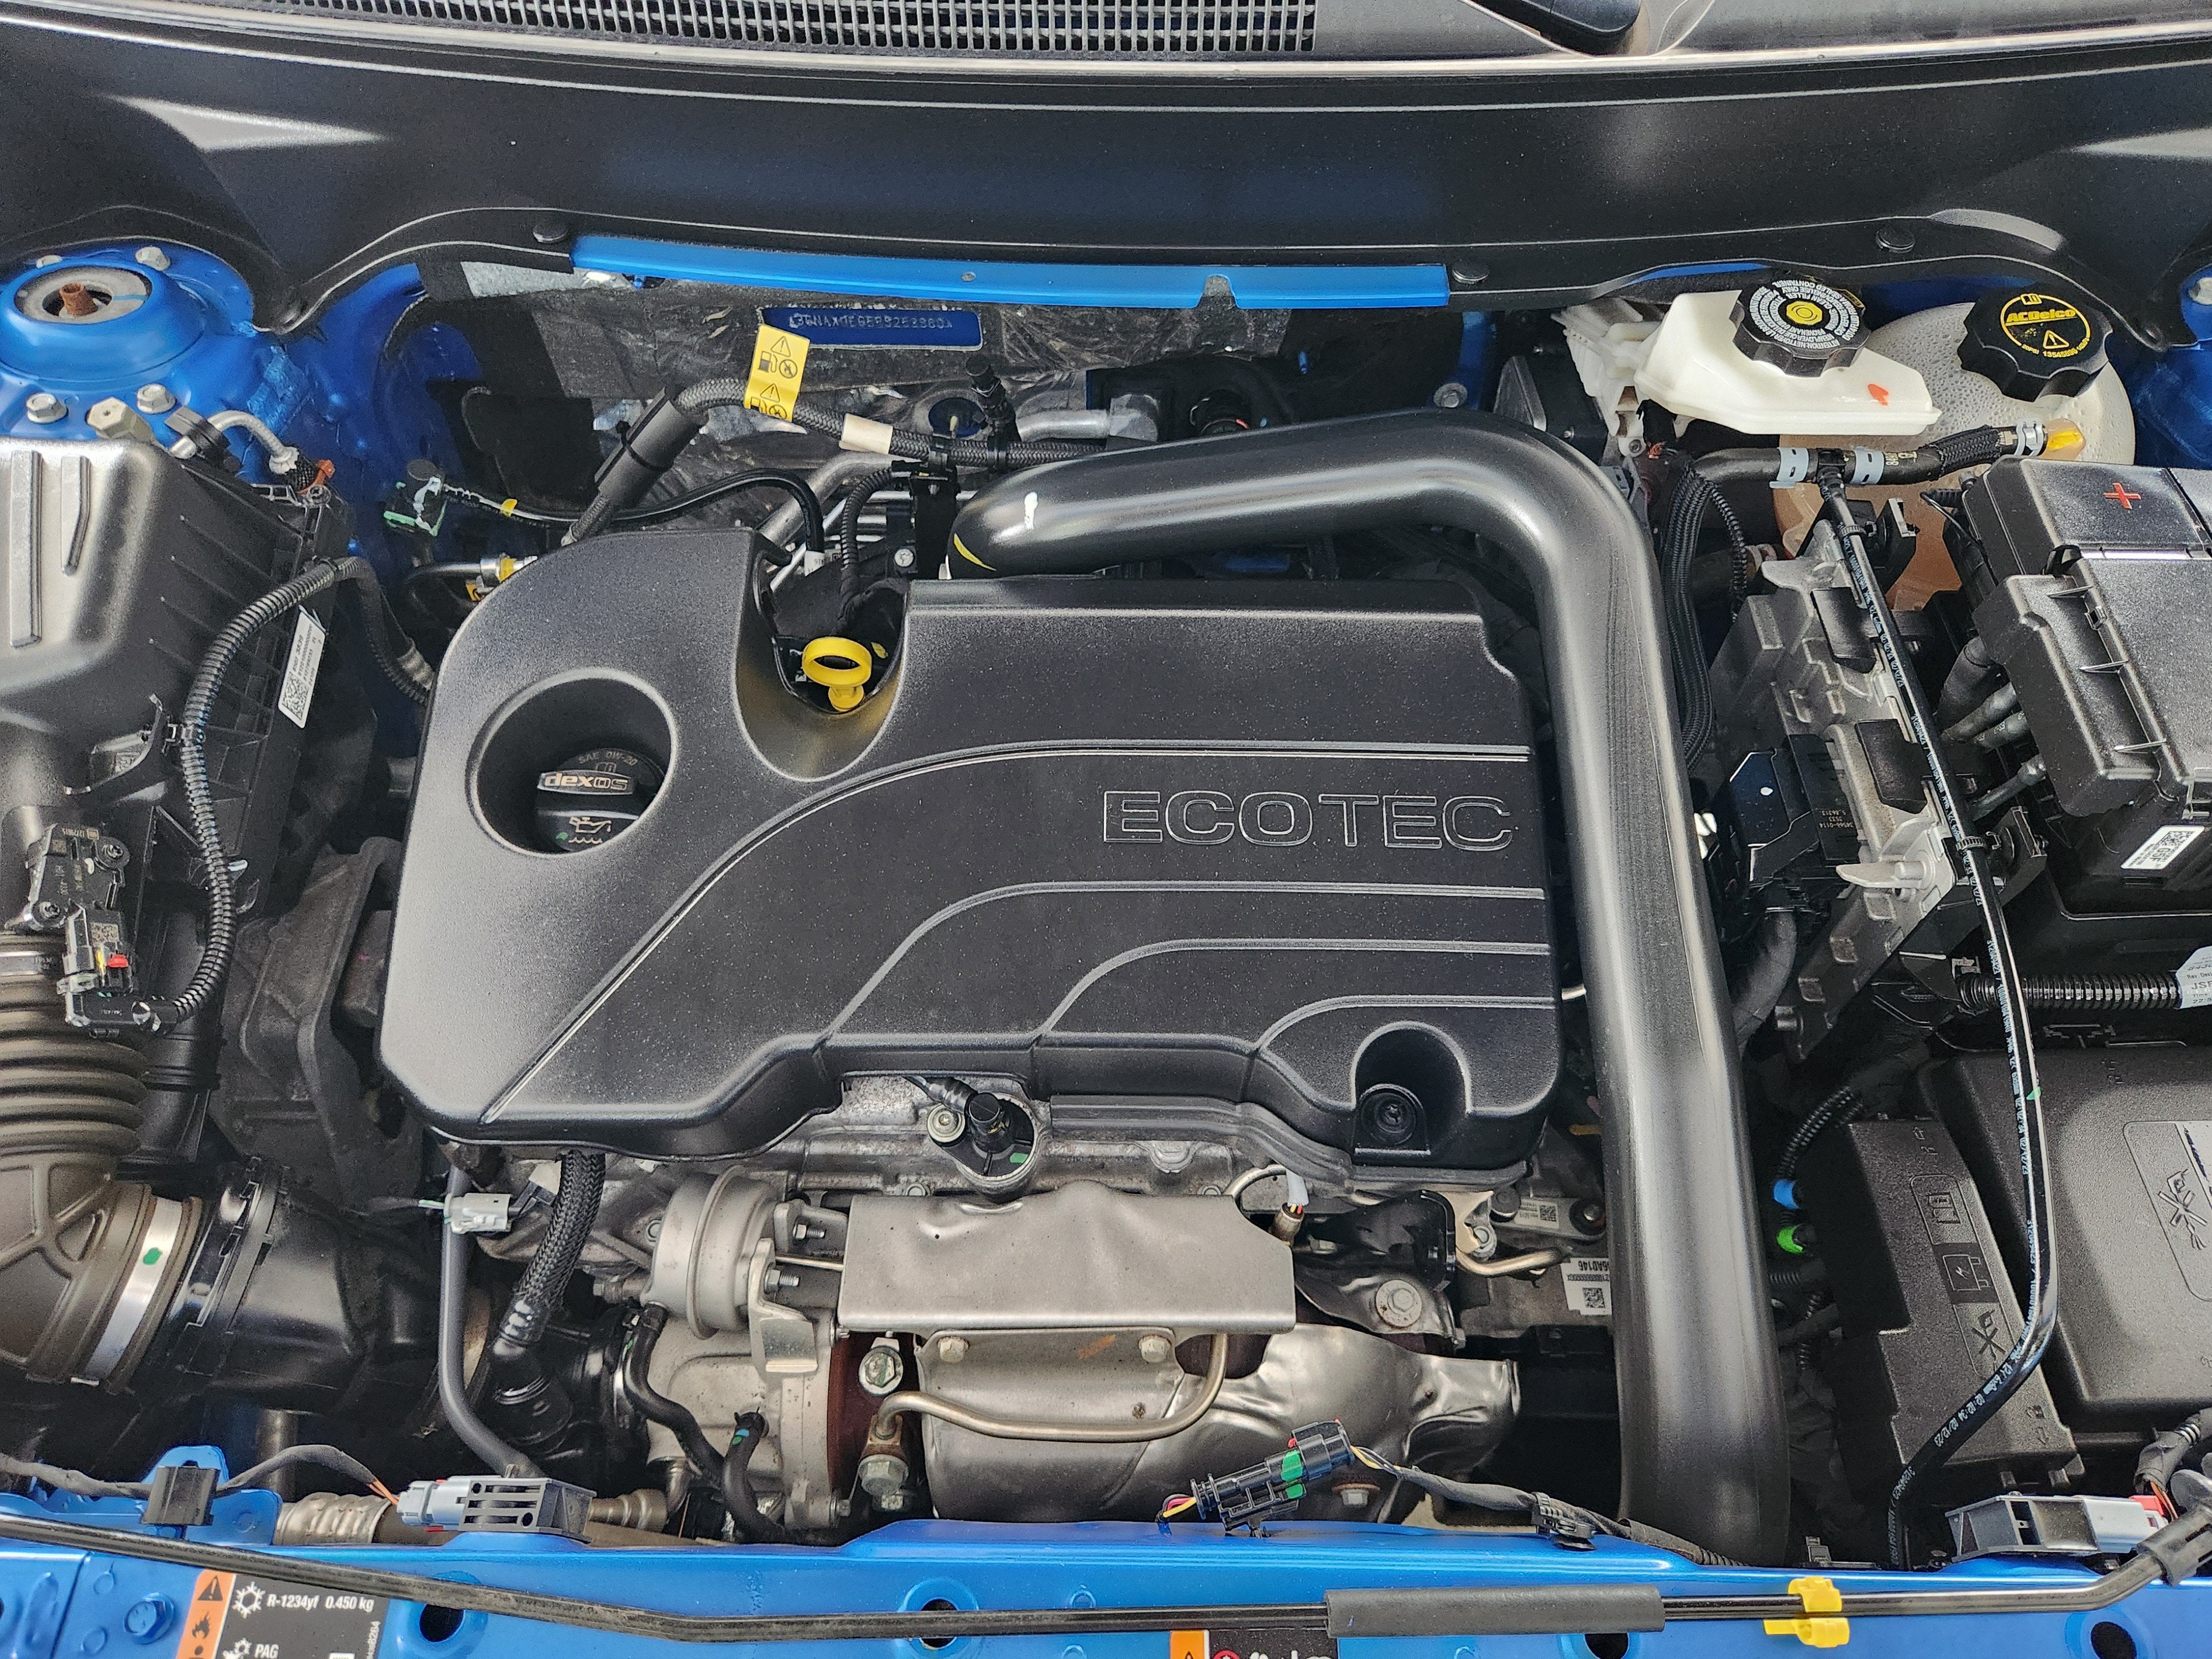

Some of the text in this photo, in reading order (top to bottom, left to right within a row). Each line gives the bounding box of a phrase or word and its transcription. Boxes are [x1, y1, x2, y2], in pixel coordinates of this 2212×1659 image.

[1778, 285, 1799, 294] ONLY
[1785, 292, 1812, 301] FILLER
[1815, 284, 1843, 300] SEALED
[1811, 295, 1835, 310] CLEAN
[1841, 300, 1858, 315] FROM
[1837, 308, 1850, 327] BEFORE
[1848, 315, 1860, 330] FLUID
[2006, 309, 2077, 322] ACDelco
[1773, 327, 1787, 335] DU
[1782, 331, 1798, 340] QUE
[1832, 325, 1848, 336] CAP
[1771, 333, 1806, 348] NETTOYER
[578, 750, 638, 765] SAE 0W-20
[544, 772, 629, 791] dexos
[1102, 789, 1514, 852] ECOTEC
[2147, 848, 2172, 861] G5F
[1956, 1392, 1986, 1423] 02:02:34
[1931, 1417, 1961, 1447] 02/12/23
[266, 1594, 375, 1613] R-1234yf 0.450 kg
[254, 1644, 279, 1659] PAG
